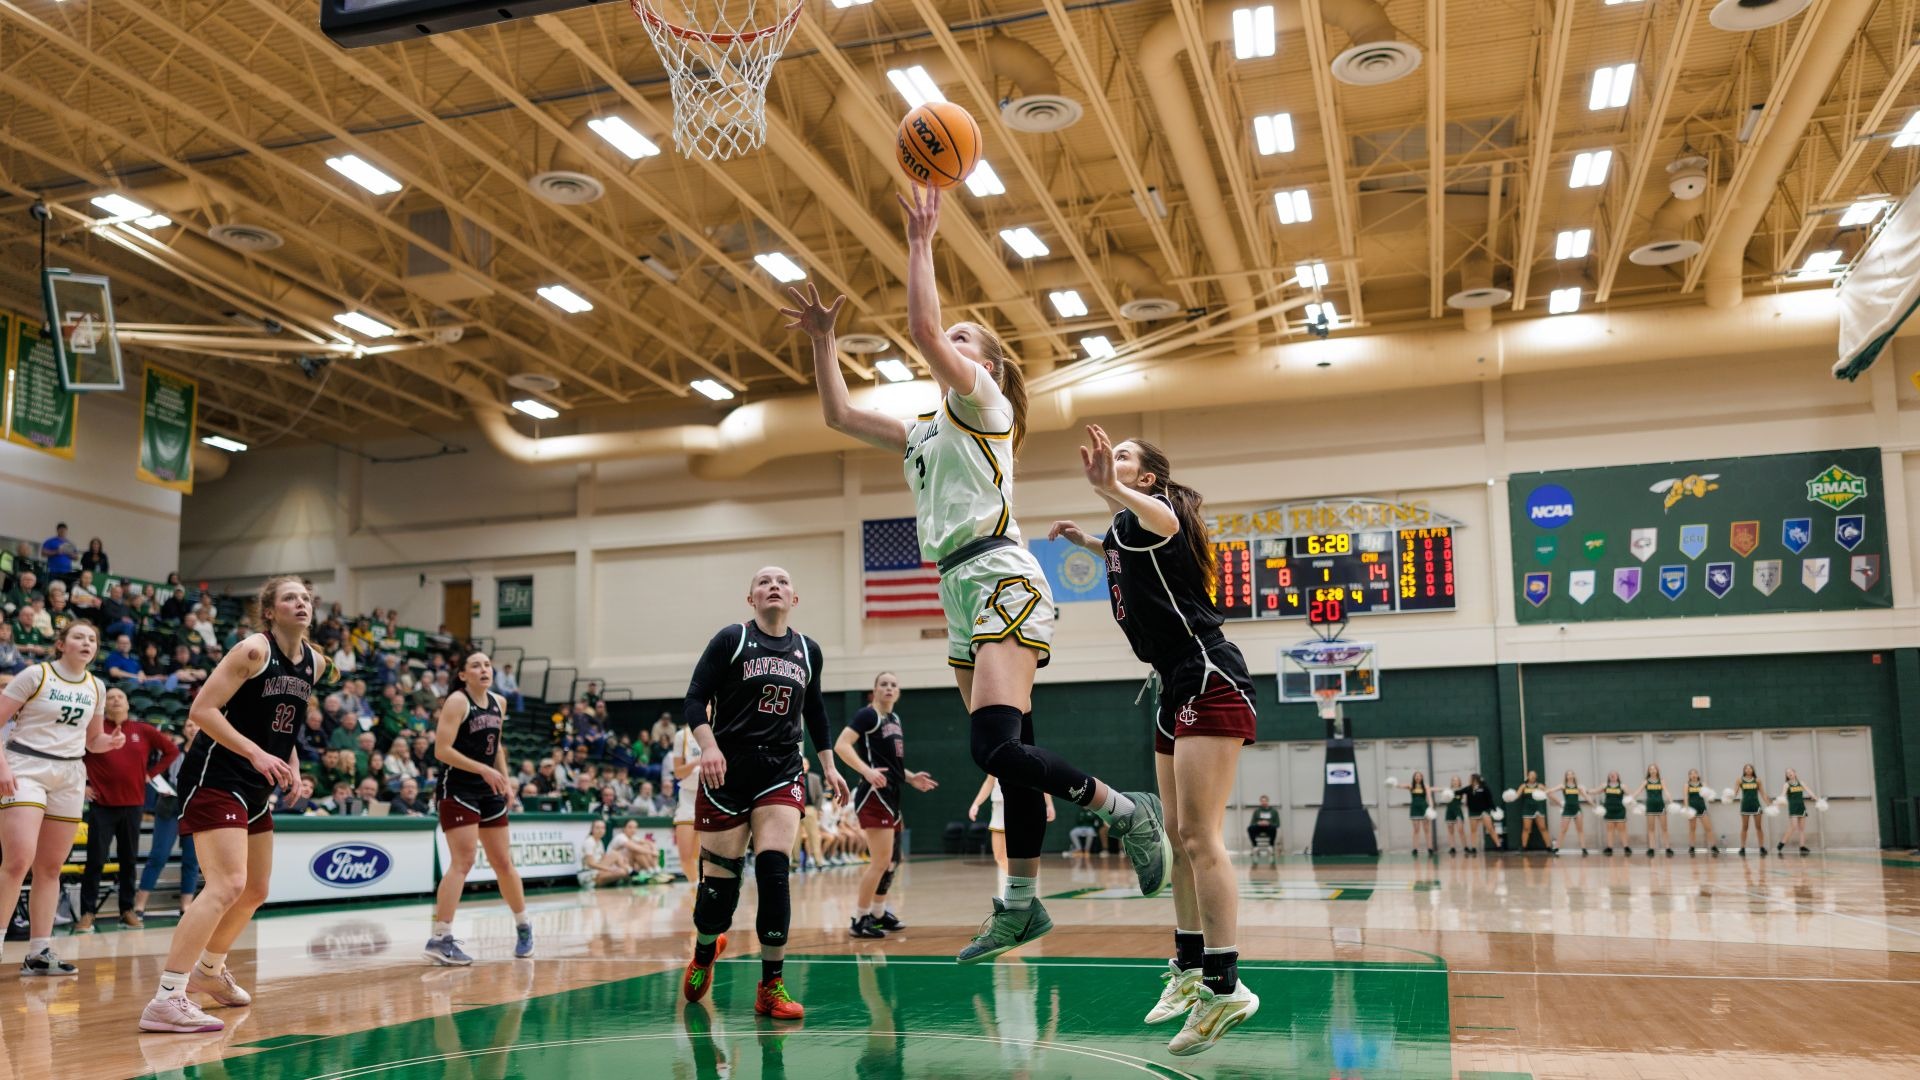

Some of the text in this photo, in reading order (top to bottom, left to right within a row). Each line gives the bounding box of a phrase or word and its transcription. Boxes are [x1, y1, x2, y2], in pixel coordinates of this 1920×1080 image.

[912, 116, 945, 157] NCAA
[1812, 481, 1862, 497] RMAC
[1216, 500, 1431, 534] FEAR THE STING
[1531, 504, 1574, 519] NCAA
[1431, 527, 1448, 538] PTS
[1307, 534, 1349, 555] 6:28
[1406, 537, 1452, 551] 3 0 3
[1224, 549, 1249, 562] 0 0
[1402, 549, 1452, 562] 12 0 0
[1224, 561, 1250, 573] 0 0
[1369, 563, 1387, 580] 14
[1403, 560, 1453, 574] 15 0 3
[1225, 573, 1233, 585] 0
[1279, 568, 1291, 587] 8
[1323, 568, 1329, 582] 1
[1400, 574, 1416, 586] 25
[1426, 573, 1434, 585] 0
[1225, 583, 1251, 596] 0 0
[1316, 588, 1344, 601] 6:28
[1352, 589, 1388, 604] 4 1
[1401, 584, 1454, 598] 32 0 0
[1226, 595, 1234, 608] 0
[1267, 593, 1298, 609] 0 4
[1310, 601, 1341, 622] 20
[743, 657, 807, 688] MAVERICKS
[49, 688, 92, 706] Black Hills
[758, 684, 792, 716] 25
[55, 705, 85, 727] 32
[271, 703, 296, 734] 32
[525, 842, 576, 866] JACKETS
[326, 848, 378, 880] Ford
